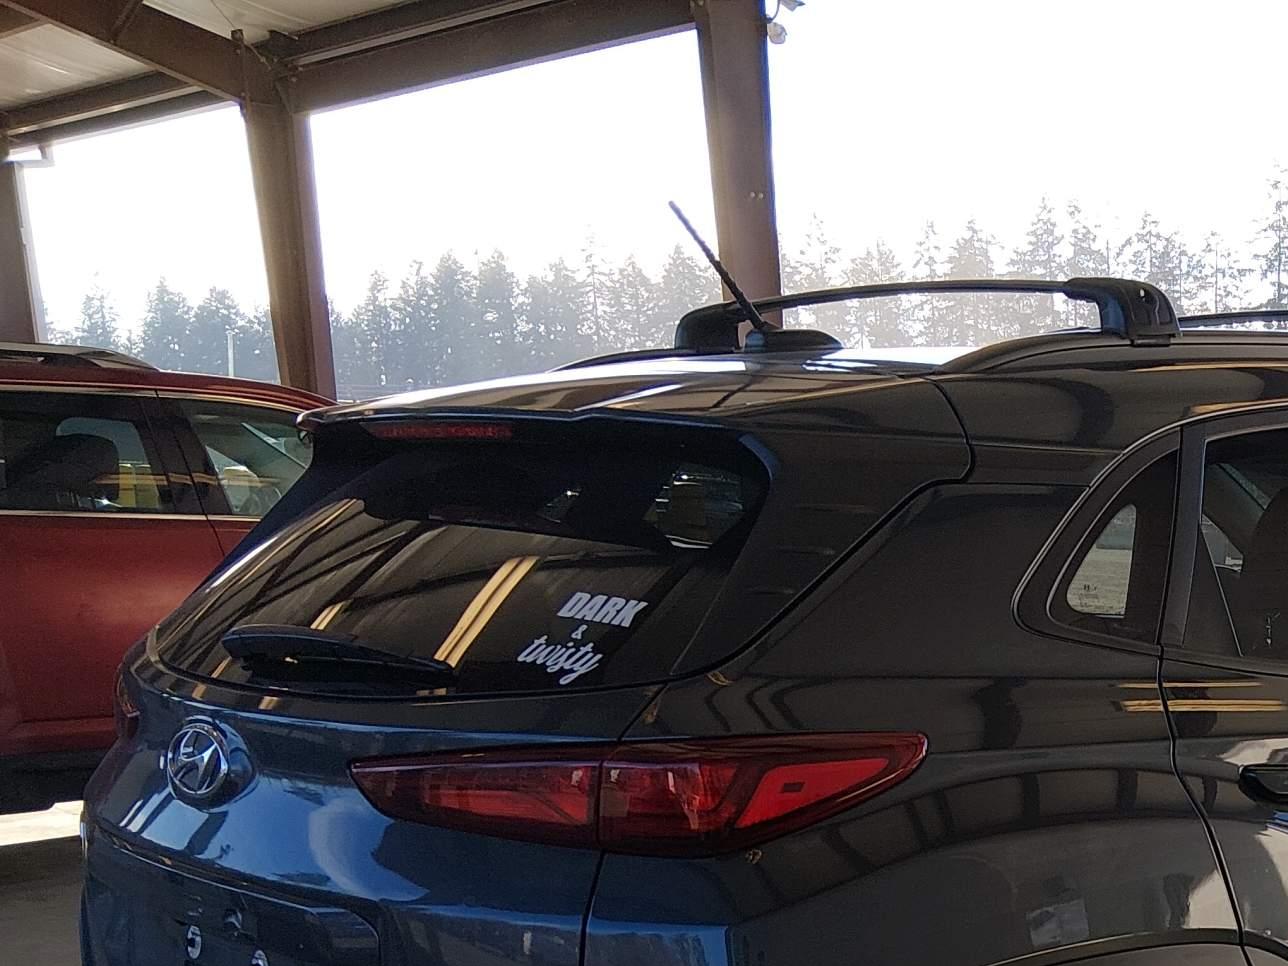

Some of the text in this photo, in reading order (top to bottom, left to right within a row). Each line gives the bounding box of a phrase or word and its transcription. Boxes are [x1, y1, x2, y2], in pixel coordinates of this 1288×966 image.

[557, 592, 648, 627] DARK
[571, 625, 588, 639] &
[517, 635, 603, 685] twisty
